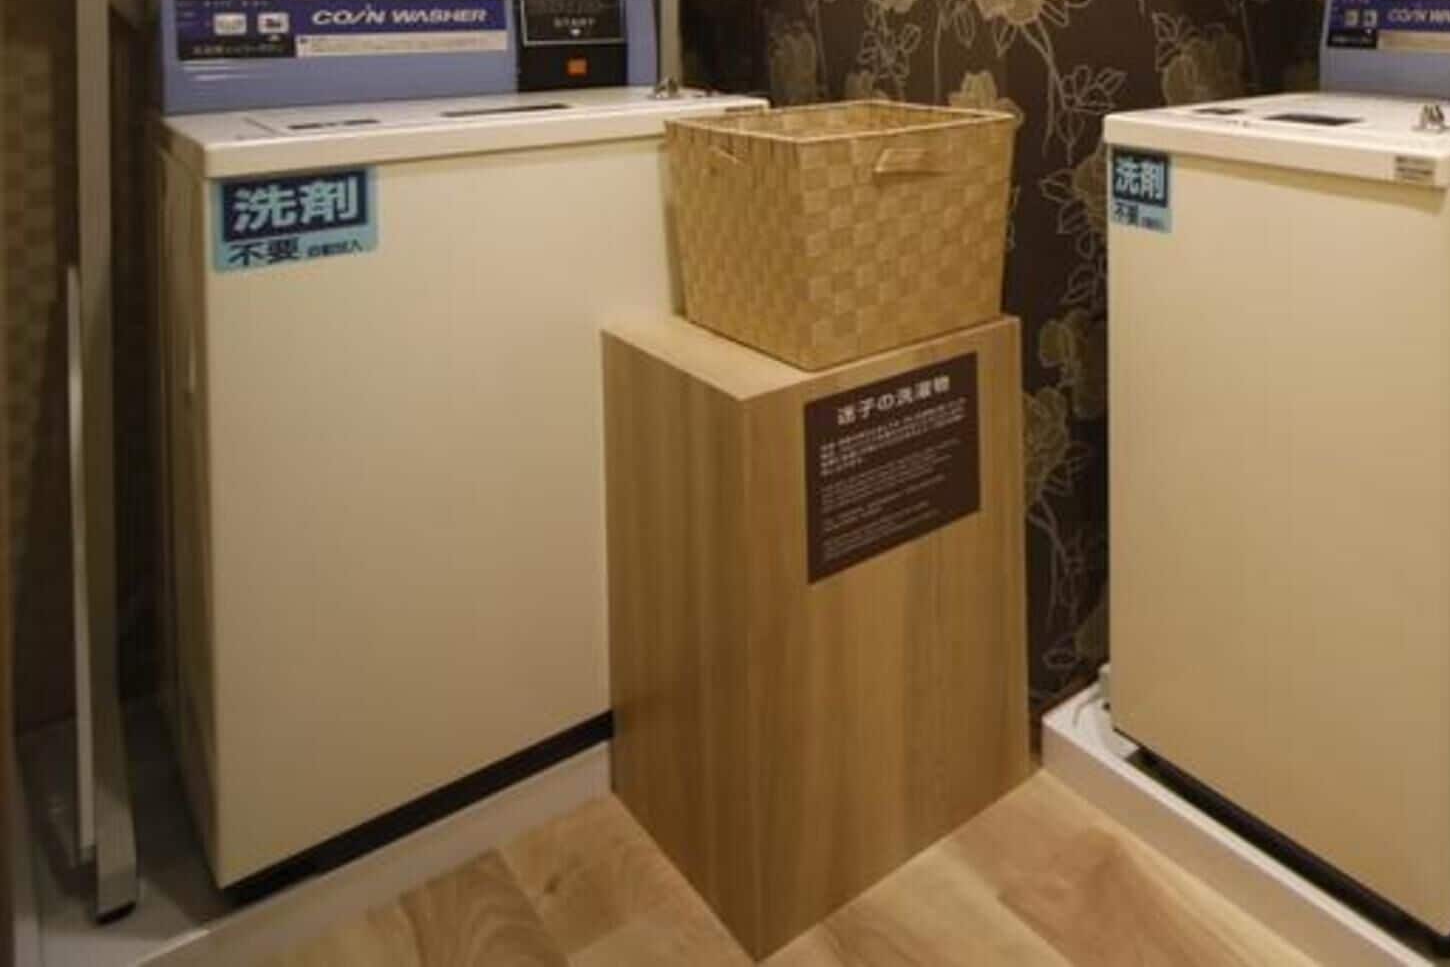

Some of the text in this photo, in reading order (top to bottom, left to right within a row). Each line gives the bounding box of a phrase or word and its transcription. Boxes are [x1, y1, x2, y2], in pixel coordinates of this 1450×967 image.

[312, 4, 488, 26] COIN WASHER
[1115, 156, 1164, 200] 洗剤
[234, 177, 358, 231] 洗剤
[227, 238, 299, 266] 不要
